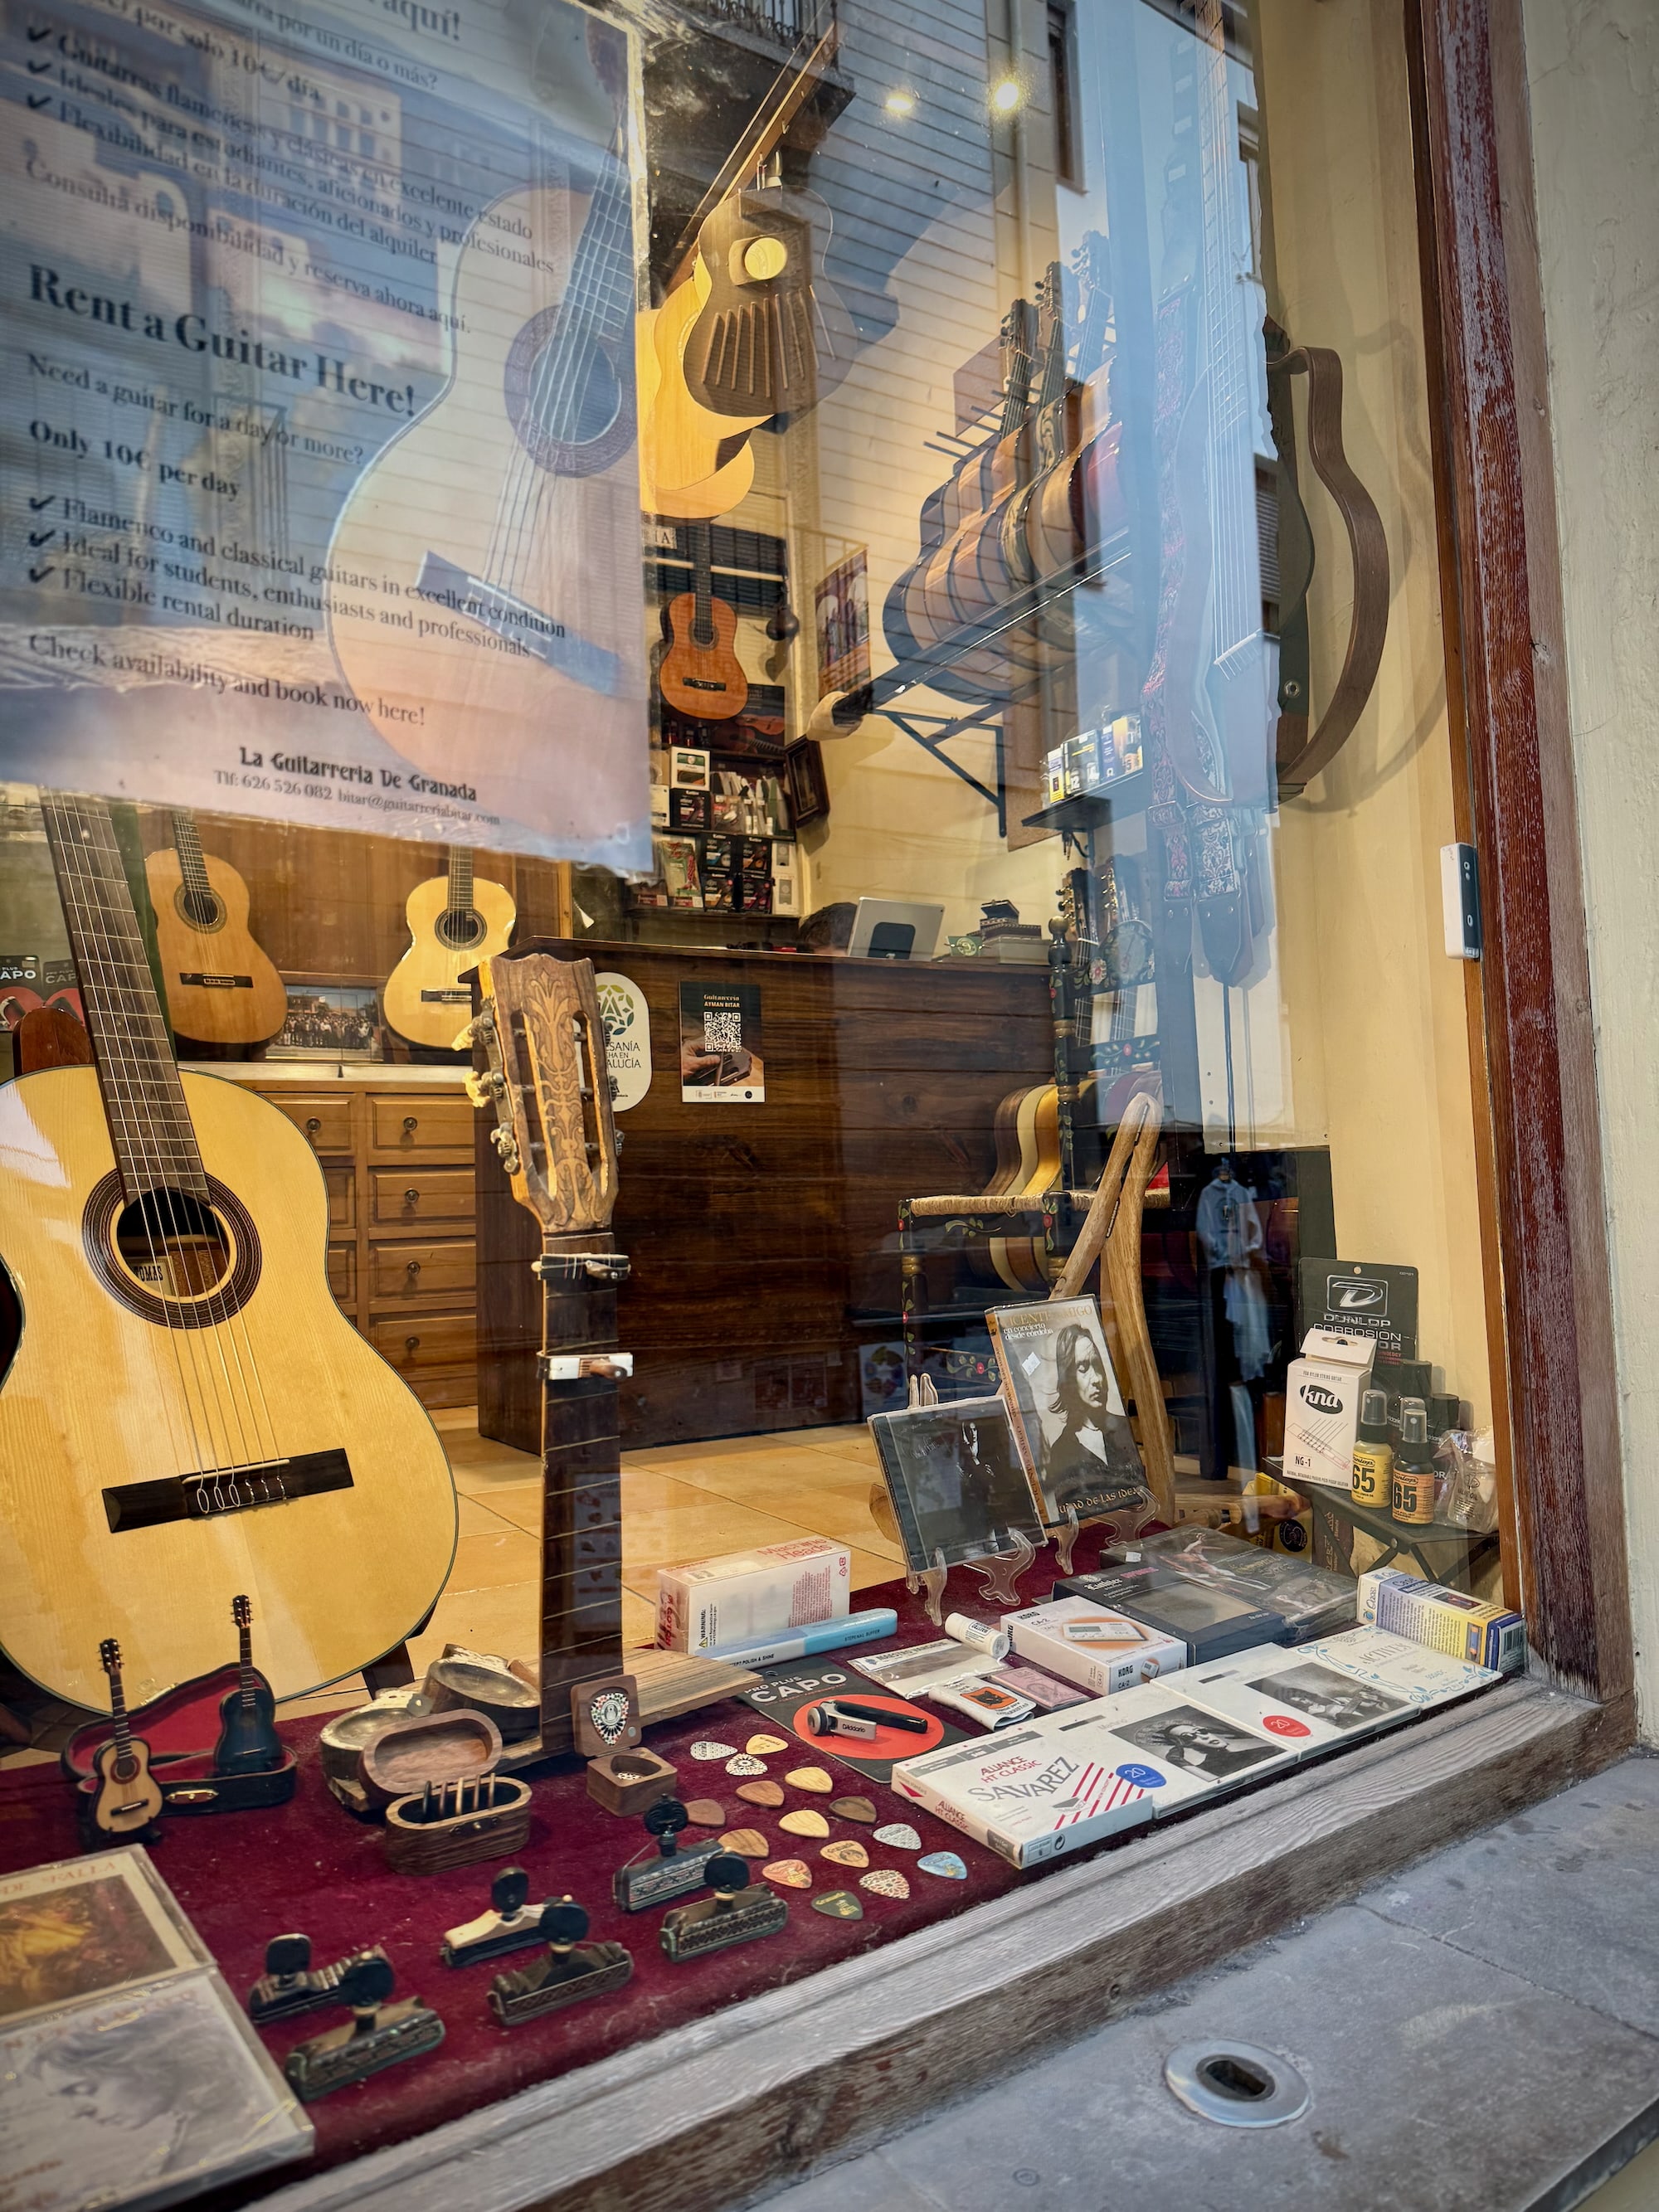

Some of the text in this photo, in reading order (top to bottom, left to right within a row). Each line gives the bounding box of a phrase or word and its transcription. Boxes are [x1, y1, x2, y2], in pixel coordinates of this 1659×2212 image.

[278, 13, 438, 90] por un día o más?
[58, 35, 161, 96] Guitarras
[362, 166, 386, 186] en
[390, 173, 474, 219] excelente
[478, 207, 533, 240] estado
[141, 110, 187, 141] para
[318, 177, 421, 228] aficionados
[425, 219, 436, 239] y
[440, 224, 555, 274] profesionales
[246, 176, 332, 225] duración
[337, 213, 366, 239] del
[369, 226, 438, 265] alquiler
[26, 158, 471, 334] Consulta disponibilidad y reserva ahora aquí.
[29, 263, 416, 416] Rent a Guitar Here!
[27, 351, 366, 465] Need a guitar for a day or more?
[29, 418, 242, 505] Only 10€ per day
[63, 498, 566, 639] Flamenco and classical guitars in excellent condition
[63, 532, 532, 658] Ideal for students, enthusiasts and professionals
[63, 567, 314, 641] Flexible rental duration
[28, 634, 426, 726] Check availability and book now here!
[239, 746, 477, 802] La Guitarreria De Granada
[214, 769, 501, 826] Tlf: 626 526 082 bitar@guitarreriabitar.com
[0, 970, 36, 980] APO
[46, 972, 78, 984] CAP
[609, 1040, 640, 1052] SANÍA
[607, 1057, 642, 1068] ALUCÍA
[1312, 1322, 1402, 1342] CORROSION
[1323, 1313, 1391, 1328] DUNLOP
[1302, 1383, 1339, 1408] kna
[1295, 1455, 1311, 1467] NG-1
[1352, 1464, 1375, 1494] 65
[1393, 1480, 1418, 1513] 65
[756, 1539, 828, 1557] Machine
[776, 1543, 834, 1560] Heads
[1017, 1611, 1040, 1621] KORG
[771, 1675, 802, 1687] PLUS
[1117, 1665, 1134, 1678] KORG
[750, 1673, 848, 1703] CAPO
[1117, 1680, 1130, 1689] CA-2
[1270, 1718, 1292, 1730] 20
[980, 1755, 1029, 1776] ALLIANCE
[980, 1759, 1043, 1783] HT CLASSIC
[1124, 1767, 1146, 1779] 20
[967, 1755, 1081, 1802] SAVAREZ
[935, 1806, 944, 1816] HT
[938, 1800, 966, 1823] ALLIANCE
[815, 1890, 847, 1906] Granada
